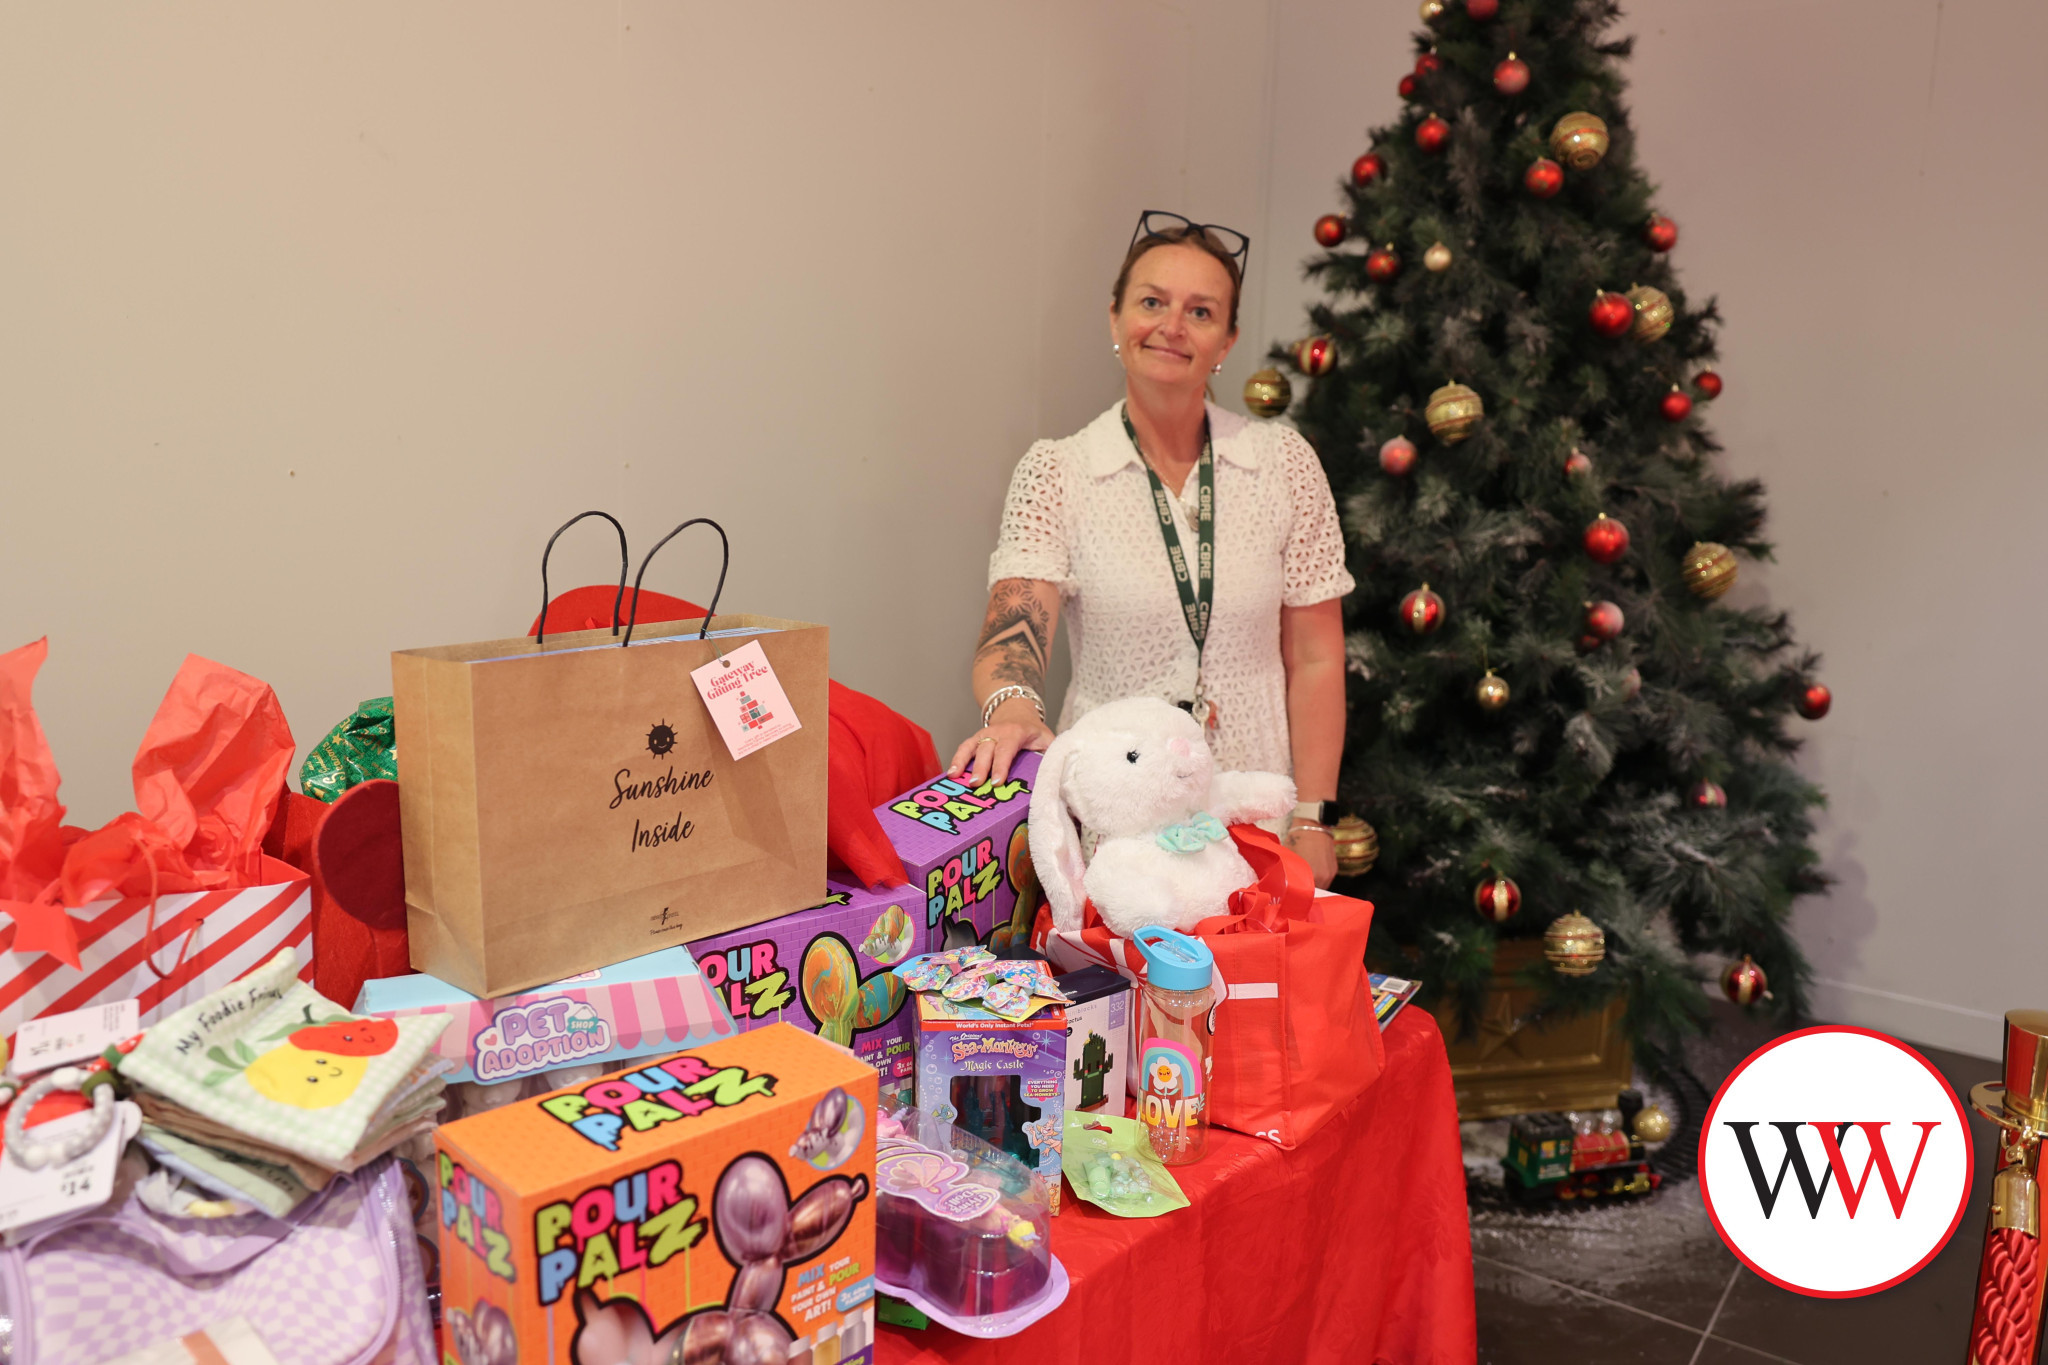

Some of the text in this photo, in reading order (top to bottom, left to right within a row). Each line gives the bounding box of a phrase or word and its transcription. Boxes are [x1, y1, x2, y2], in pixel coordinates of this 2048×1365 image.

[1154, 489, 1171, 526] CBRE
[1200, 485, 1212, 522] CBRE
[1170, 545, 1189, 583] CBRE
[1200, 542, 1212, 580] CBRE
[707, 666, 768, 700] Gifting Tree
[711, 661, 755, 688] Gateway
[609, 766, 714, 809] Sunshine
[632, 811, 695, 853] Inside
[927, 837, 994, 899] POUR
[926, 857, 1004, 929] PALZ
[699, 939, 778, 988] OUR
[714, 967, 796, 1019] LZ
[1110, 1001, 1124, 1013] 332
[175, 1030, 204, 1055] My
[197, 1000, 246, 1034] Foodie
[502, 1002, 569, 1046] PET
[571, 1020, 595, 1030] SHOP
[483, 1025, 605, 1074] ADOPTION
[861, 1036, 903, 1053] MIX YOUR
[875, 1058, 892, 1068] OWN
[876, 1051, 883, 1059] &
[886, 1042, 911, 1056] POUR
[960, 1060, 1024, 1072] Magic Castle
[538, 1056, 719, 1123] POUR
[571, 1067, 780, 1151] PALZ
[1139, 1089, 1199, 1129] LOVE
[439, 1150, 503, 1234] POUR
[534, 1158, 685, 1257] POUR
[440, 1187, 517, 1284] PALZ
[537, 1194, 709, 1306] PALZ
[797, 1256, 851, 1288] MIX YOUR
[829, 1262, 860, 1286] POUR
[804, 1299, 832, 1322] ART!
